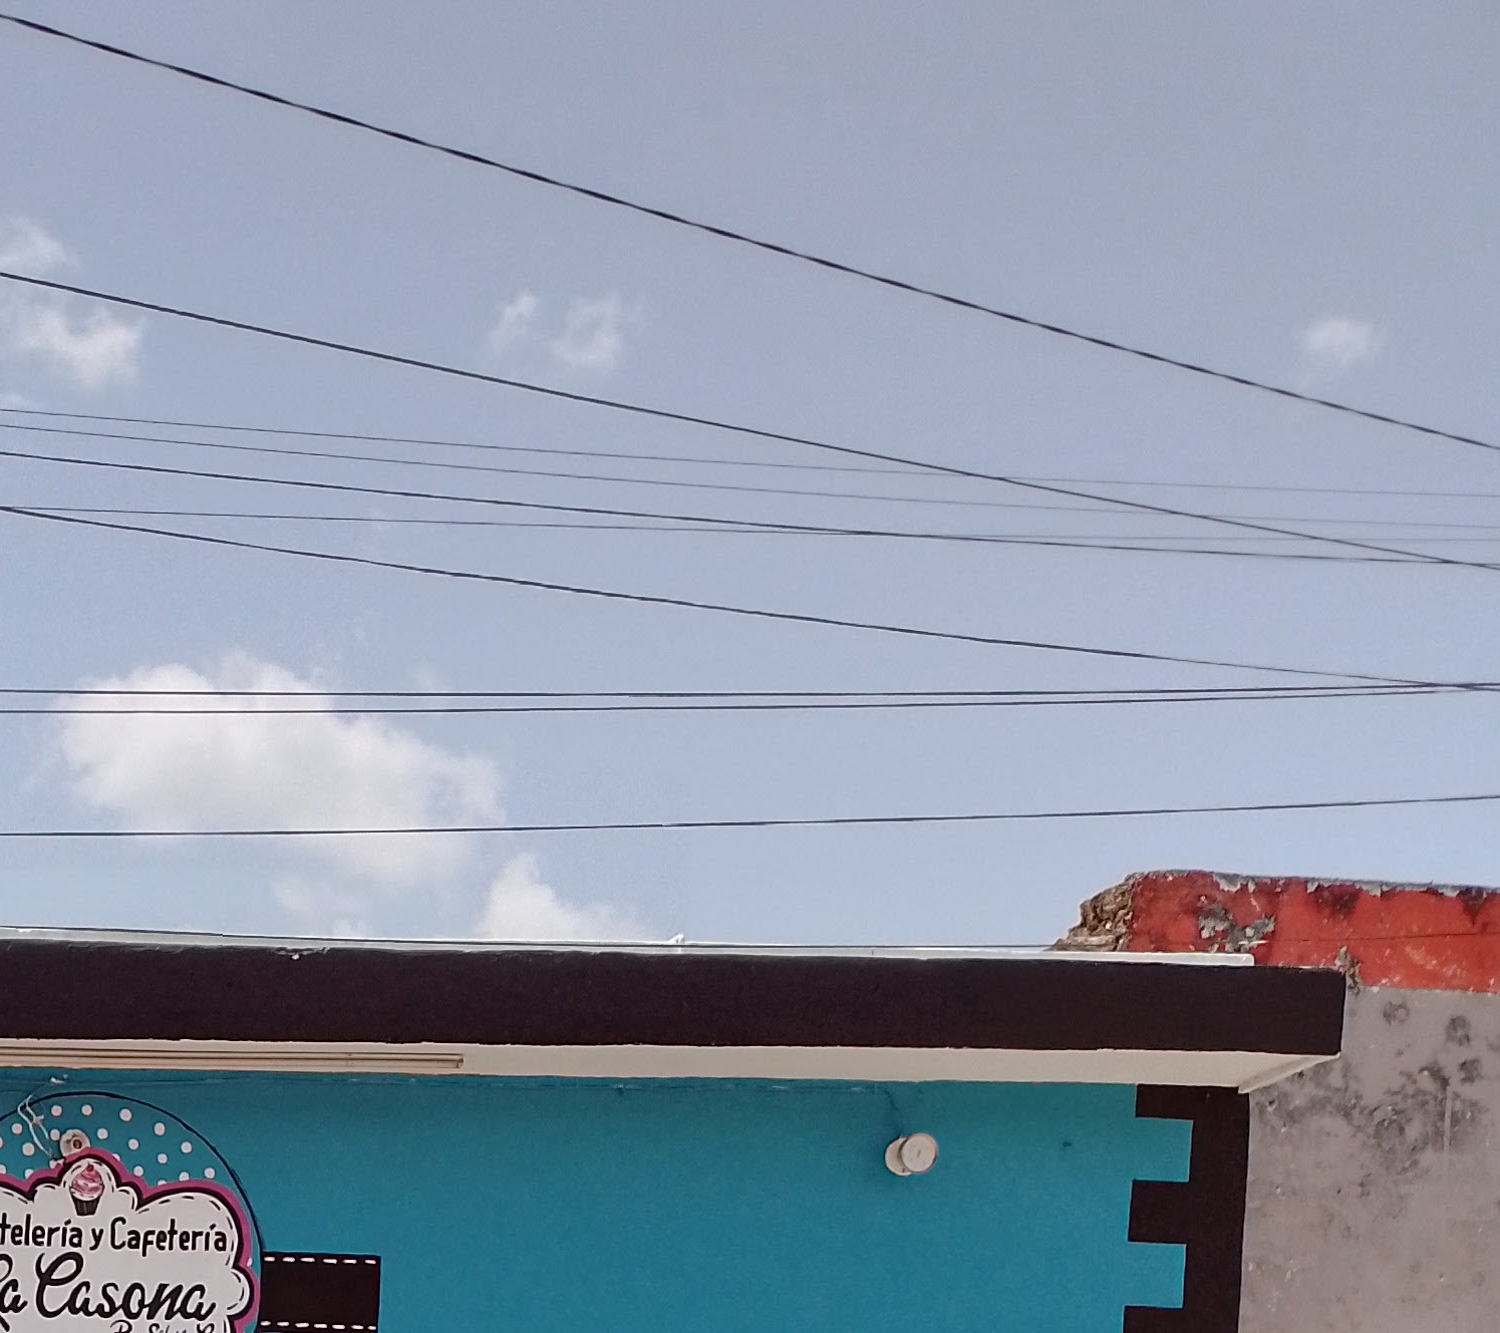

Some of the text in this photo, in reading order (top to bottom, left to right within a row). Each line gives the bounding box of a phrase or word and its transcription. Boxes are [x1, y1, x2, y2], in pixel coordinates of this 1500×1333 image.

[90, 1227, 105, 1250] y
[110, 1216, 228, 1257] Cafetería
[35, 1251, 216, 1320] Casona
